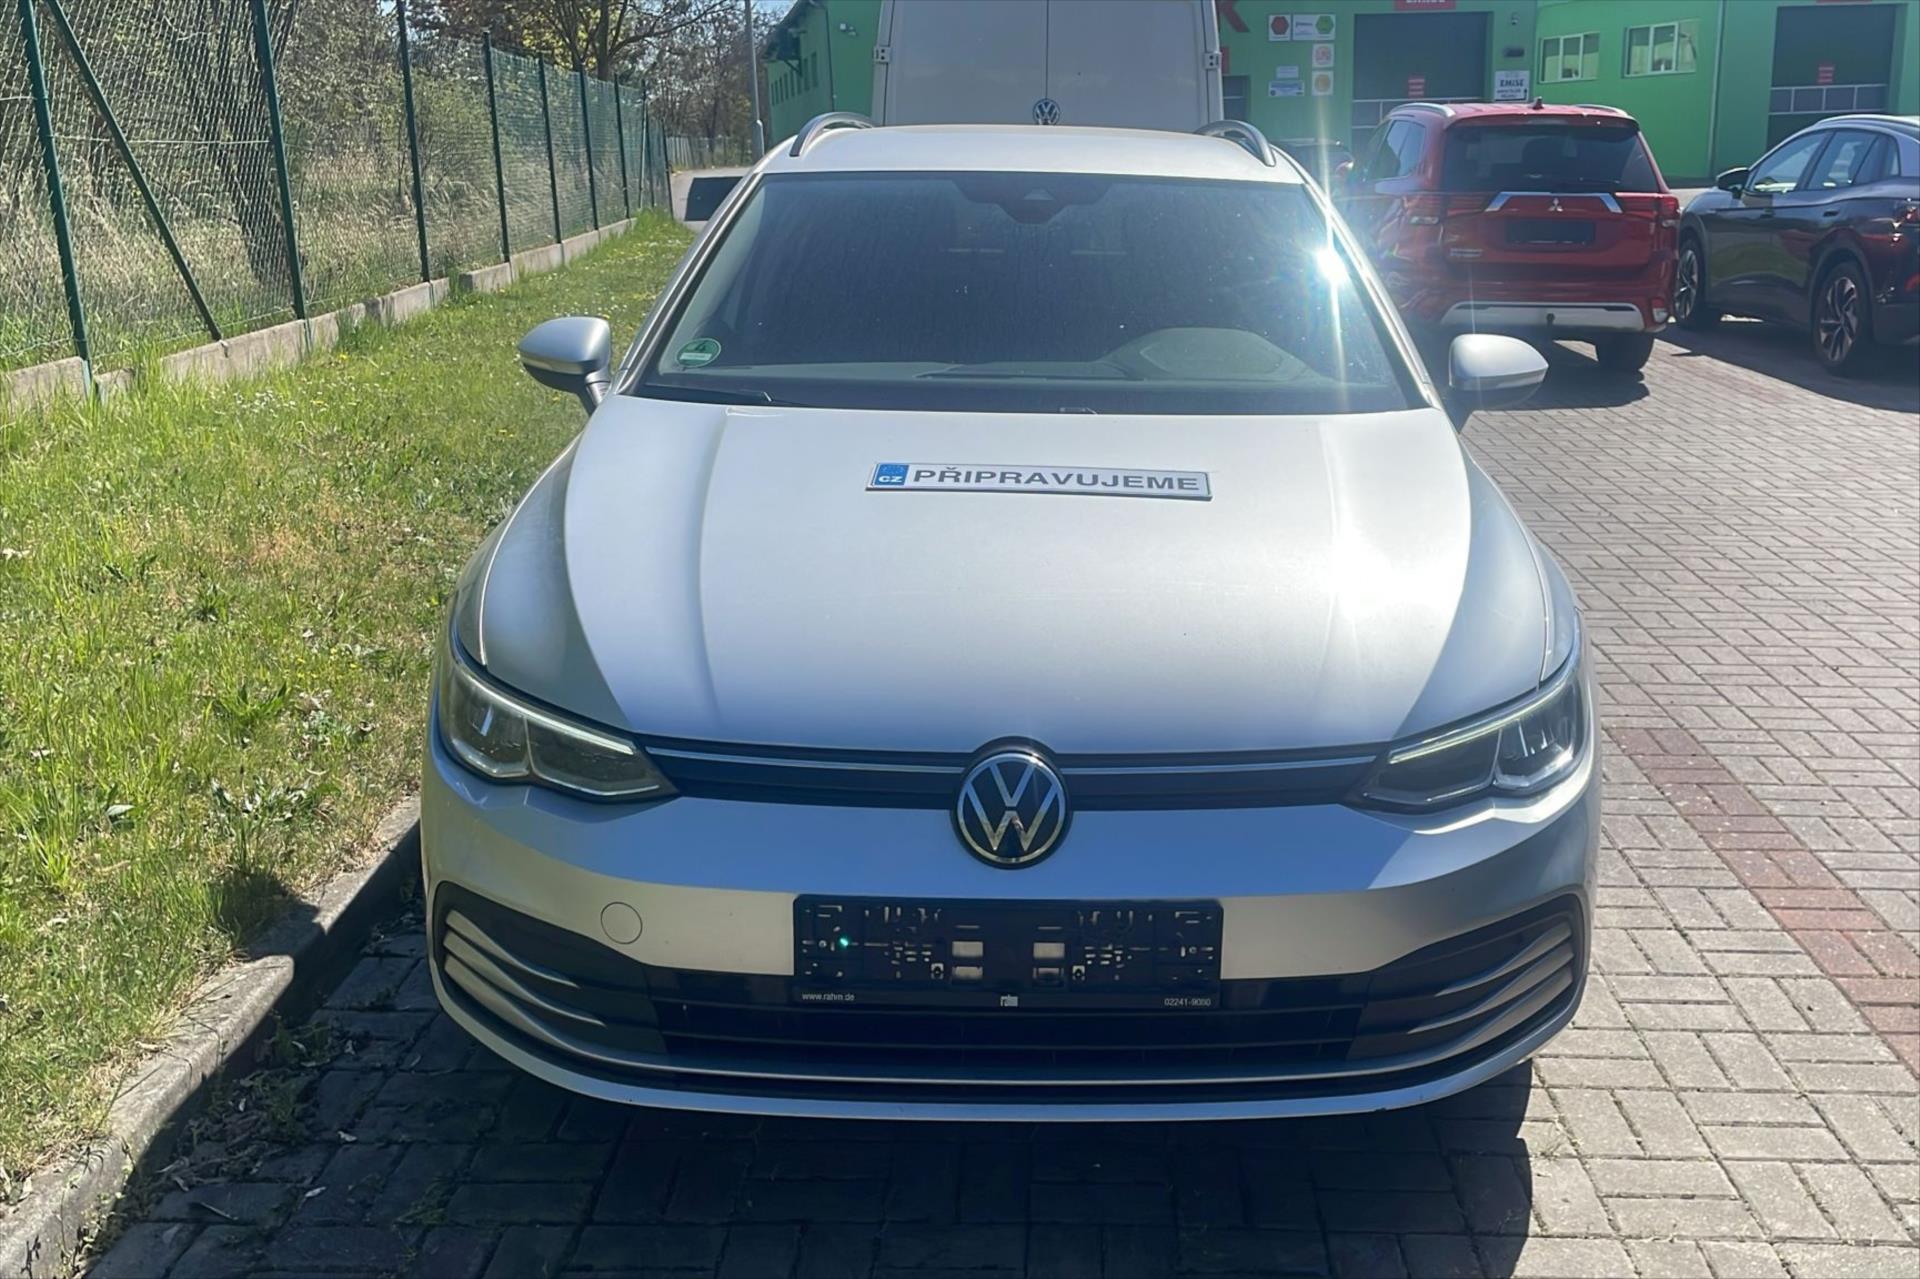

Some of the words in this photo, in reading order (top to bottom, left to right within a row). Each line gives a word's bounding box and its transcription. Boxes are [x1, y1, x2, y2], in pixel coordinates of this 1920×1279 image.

[878, 475, 903, 483] CZ
[913, 467, 1200, 491] PŘIPRAVUJEME
[963, 758, 1060, 852] VW
